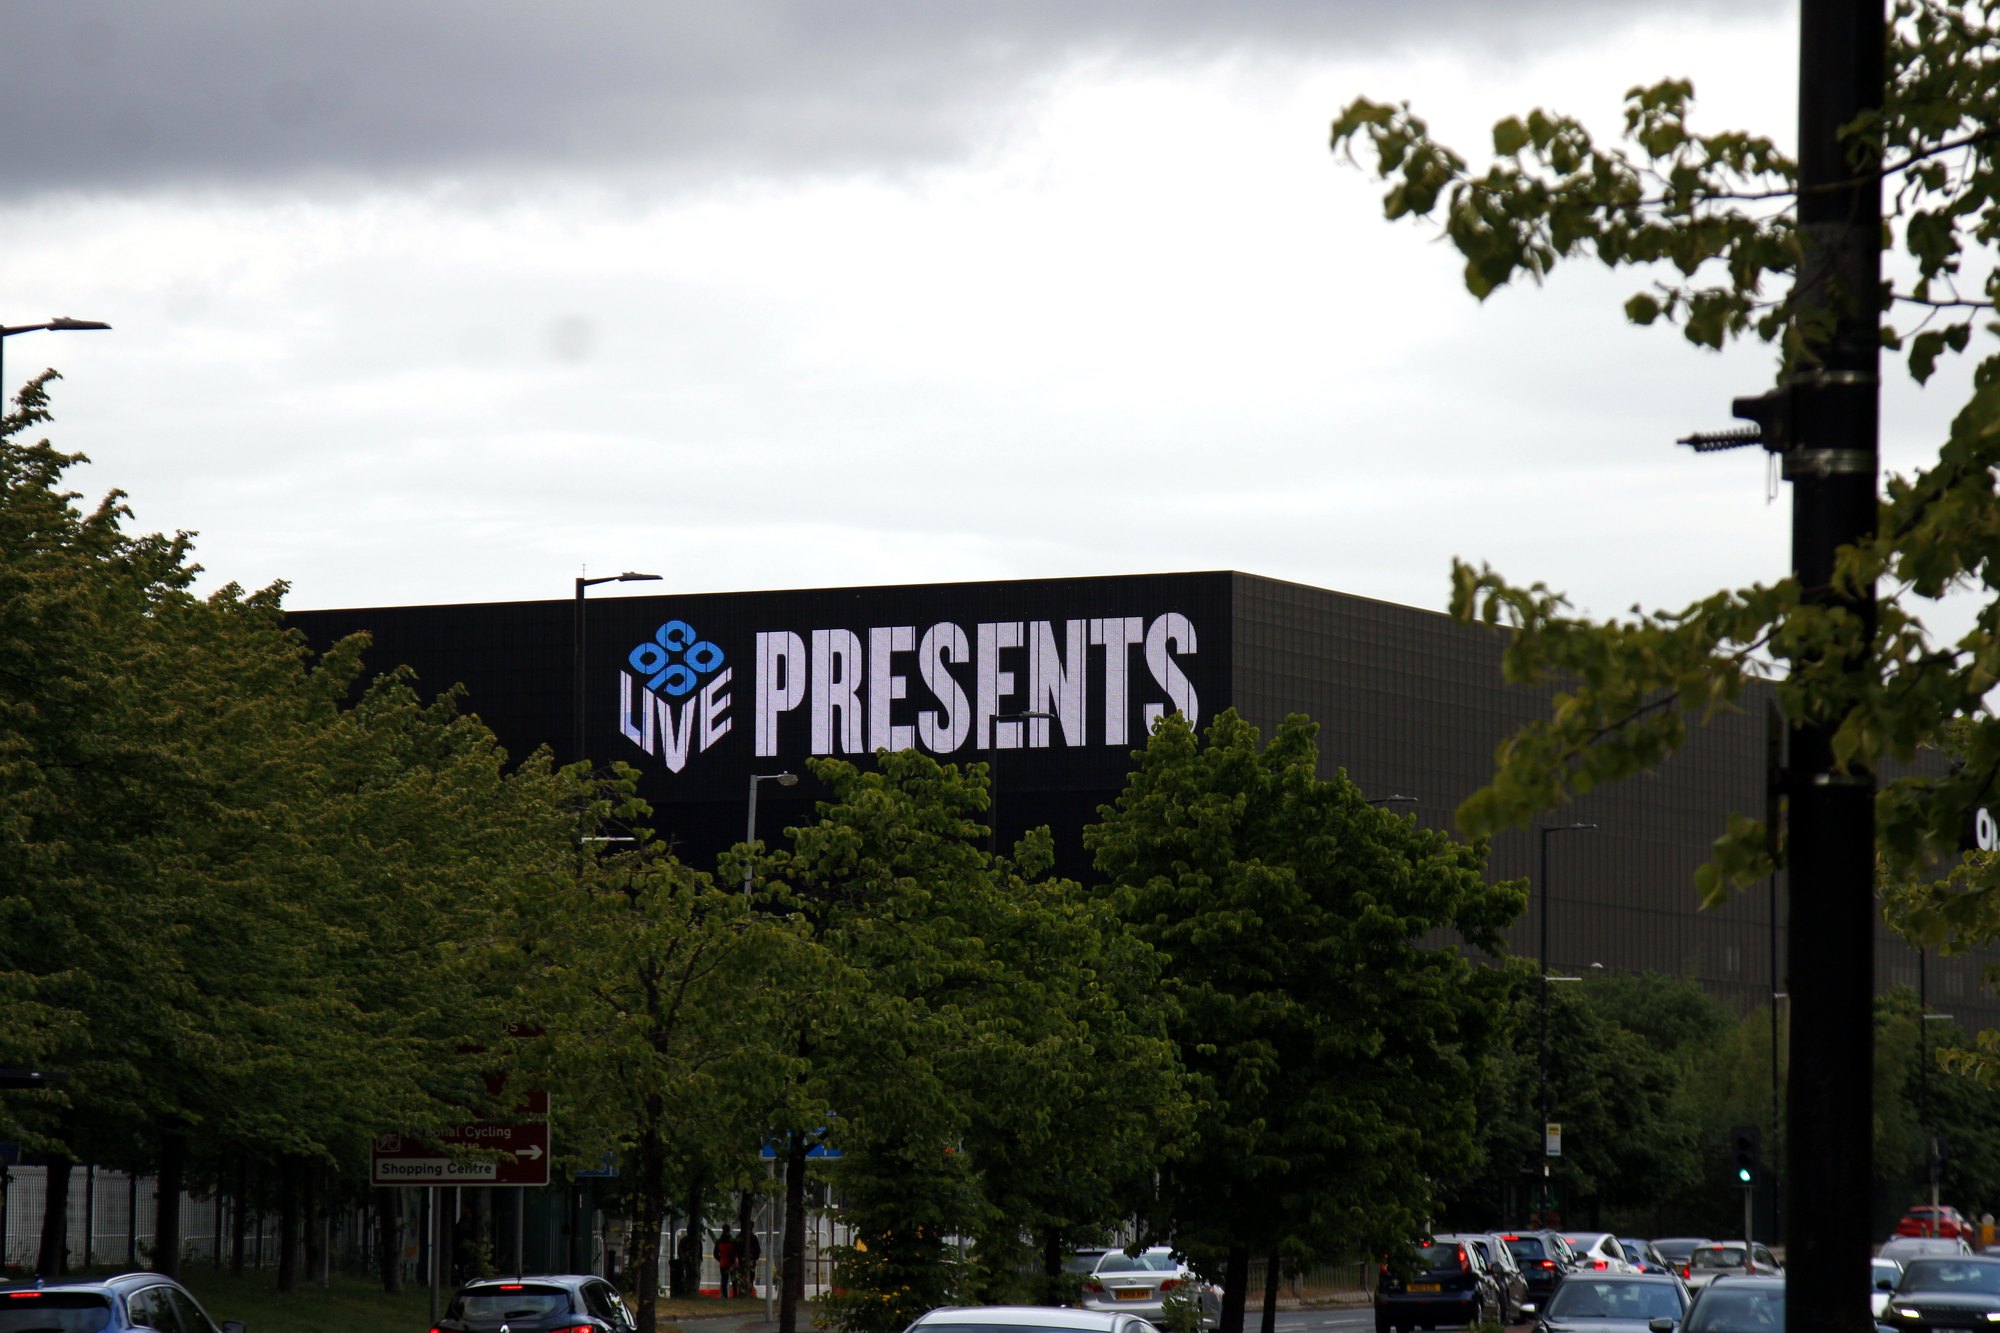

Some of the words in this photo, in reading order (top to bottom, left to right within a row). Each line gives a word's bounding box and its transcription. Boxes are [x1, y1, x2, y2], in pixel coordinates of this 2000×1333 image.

[619, 666, 733, 774] LIVE
[755, 612, 1199, 757] PRESENTS
[464, 1126, 512, 1140] Cycling
[381, 1163, 443, 1176] Shopping
